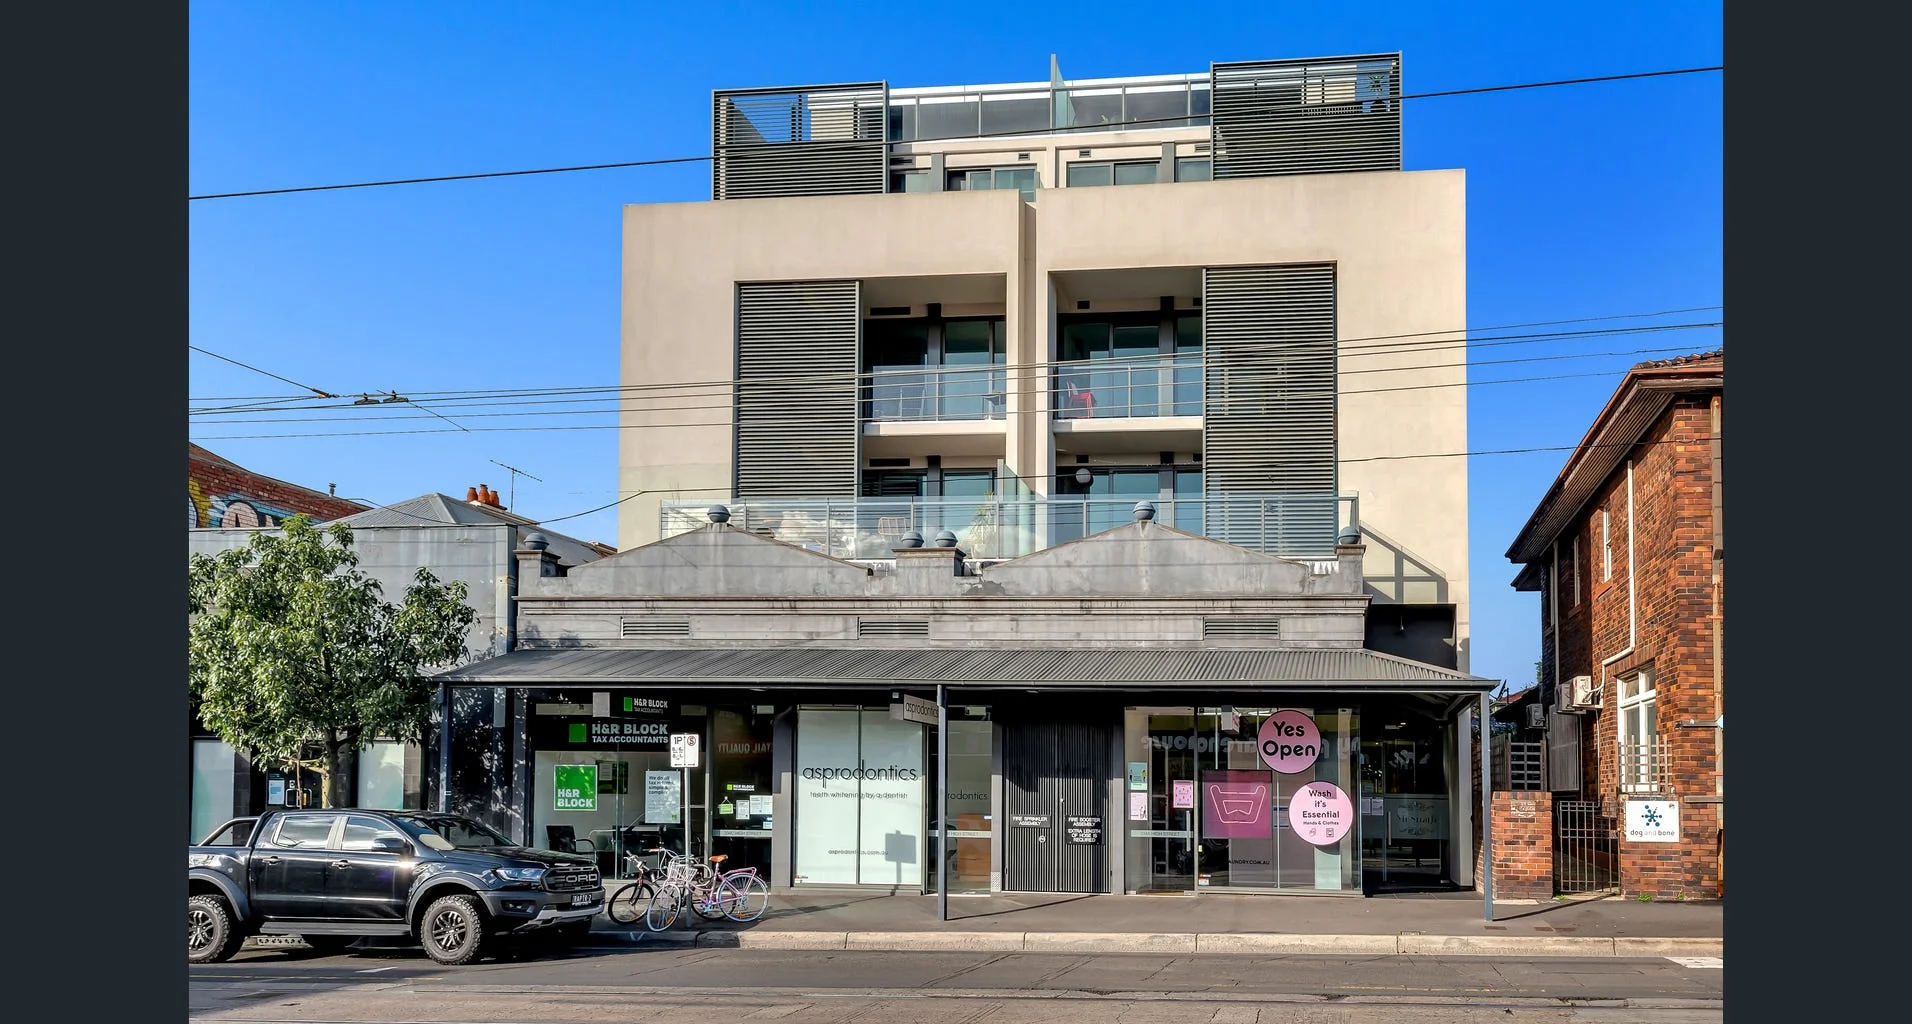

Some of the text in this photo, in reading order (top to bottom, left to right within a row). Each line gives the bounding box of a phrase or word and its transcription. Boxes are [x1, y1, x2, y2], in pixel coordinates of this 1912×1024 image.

[633, 697, 668, 709] H&R BLOCK
[592, 723, 668, 735] H&R BLOCK
[1272, 721, 1305, 737] Yes
[674, 736, 682, 744] 1P
[1262, 740, 1316, 760] Open
[802, 759, 918, 789] asprodontics
[557, 788, 580, 798] H&R
[947, 788, 988, 800] rodontics
[557, 799, 593, 807] BLOCK
[553, 873, 598, 883] FORD
